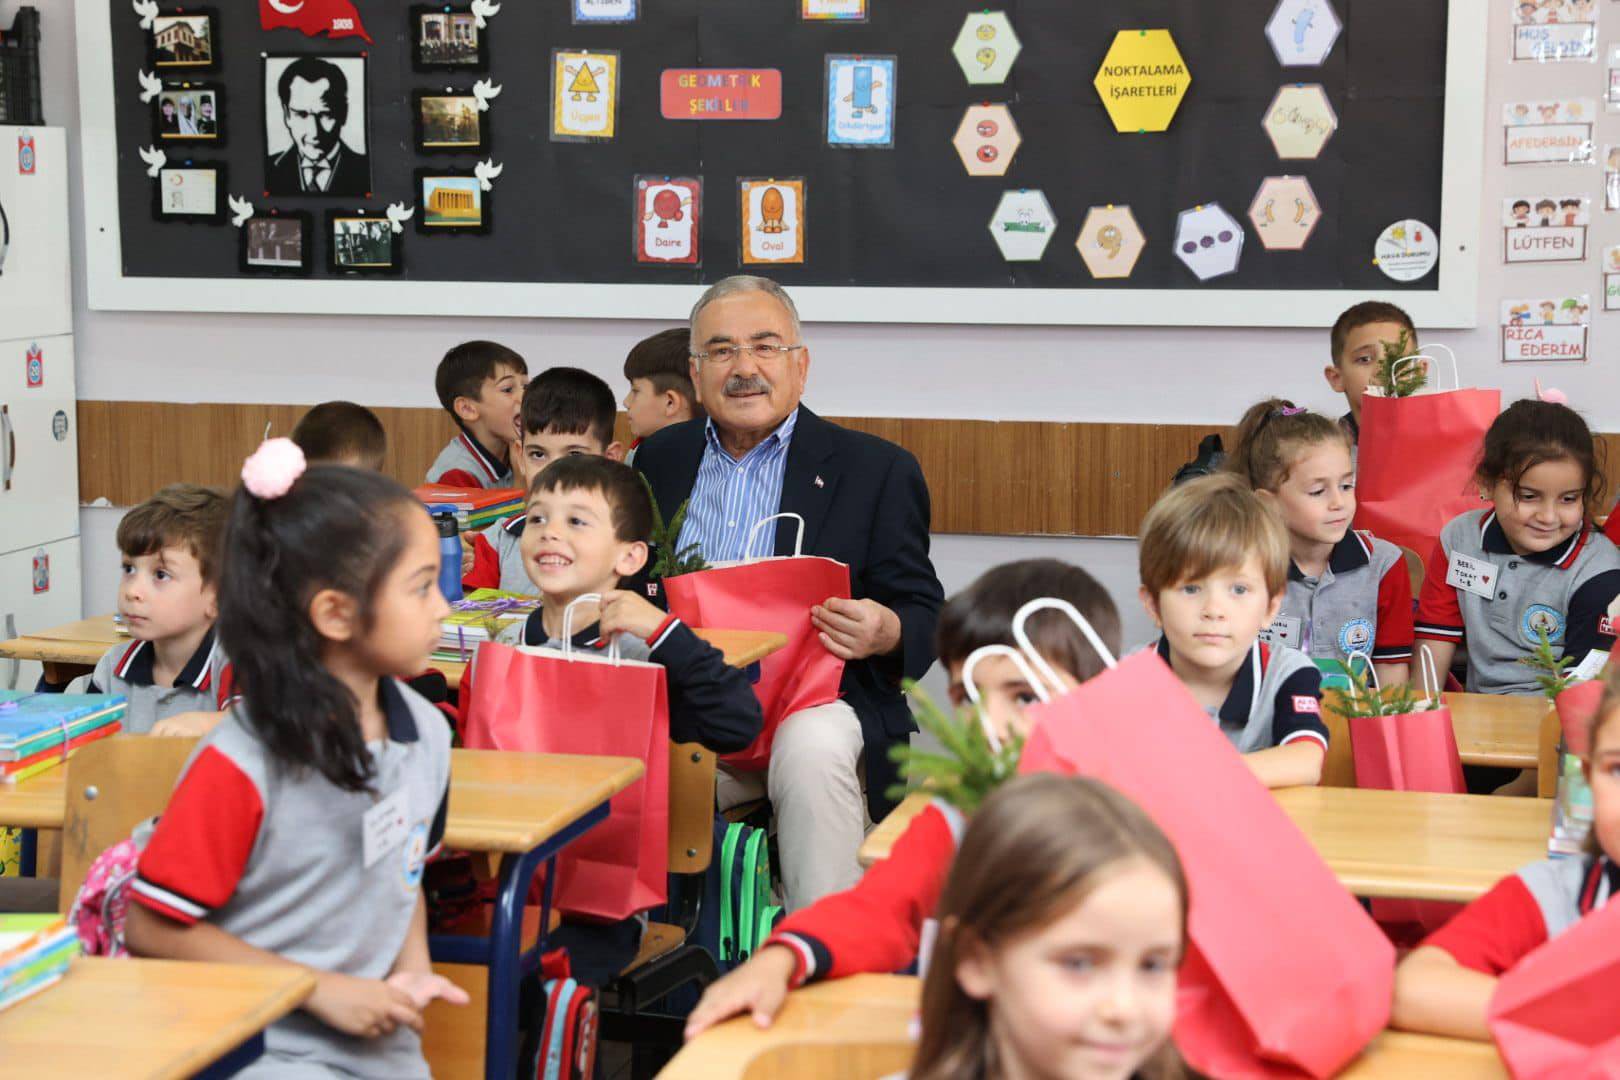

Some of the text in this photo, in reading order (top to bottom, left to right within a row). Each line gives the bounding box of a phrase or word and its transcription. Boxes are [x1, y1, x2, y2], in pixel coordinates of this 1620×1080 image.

[1104, 64, 1184, 77] NOKTALAMA
[1110, 83, 1177, 100] İŞARETLERİ
[761, 240, 784, 251] Oval
[1512, 234, 1575, 250] LÜTFEN
[1520, 341, 1582, 356] EDERİM
